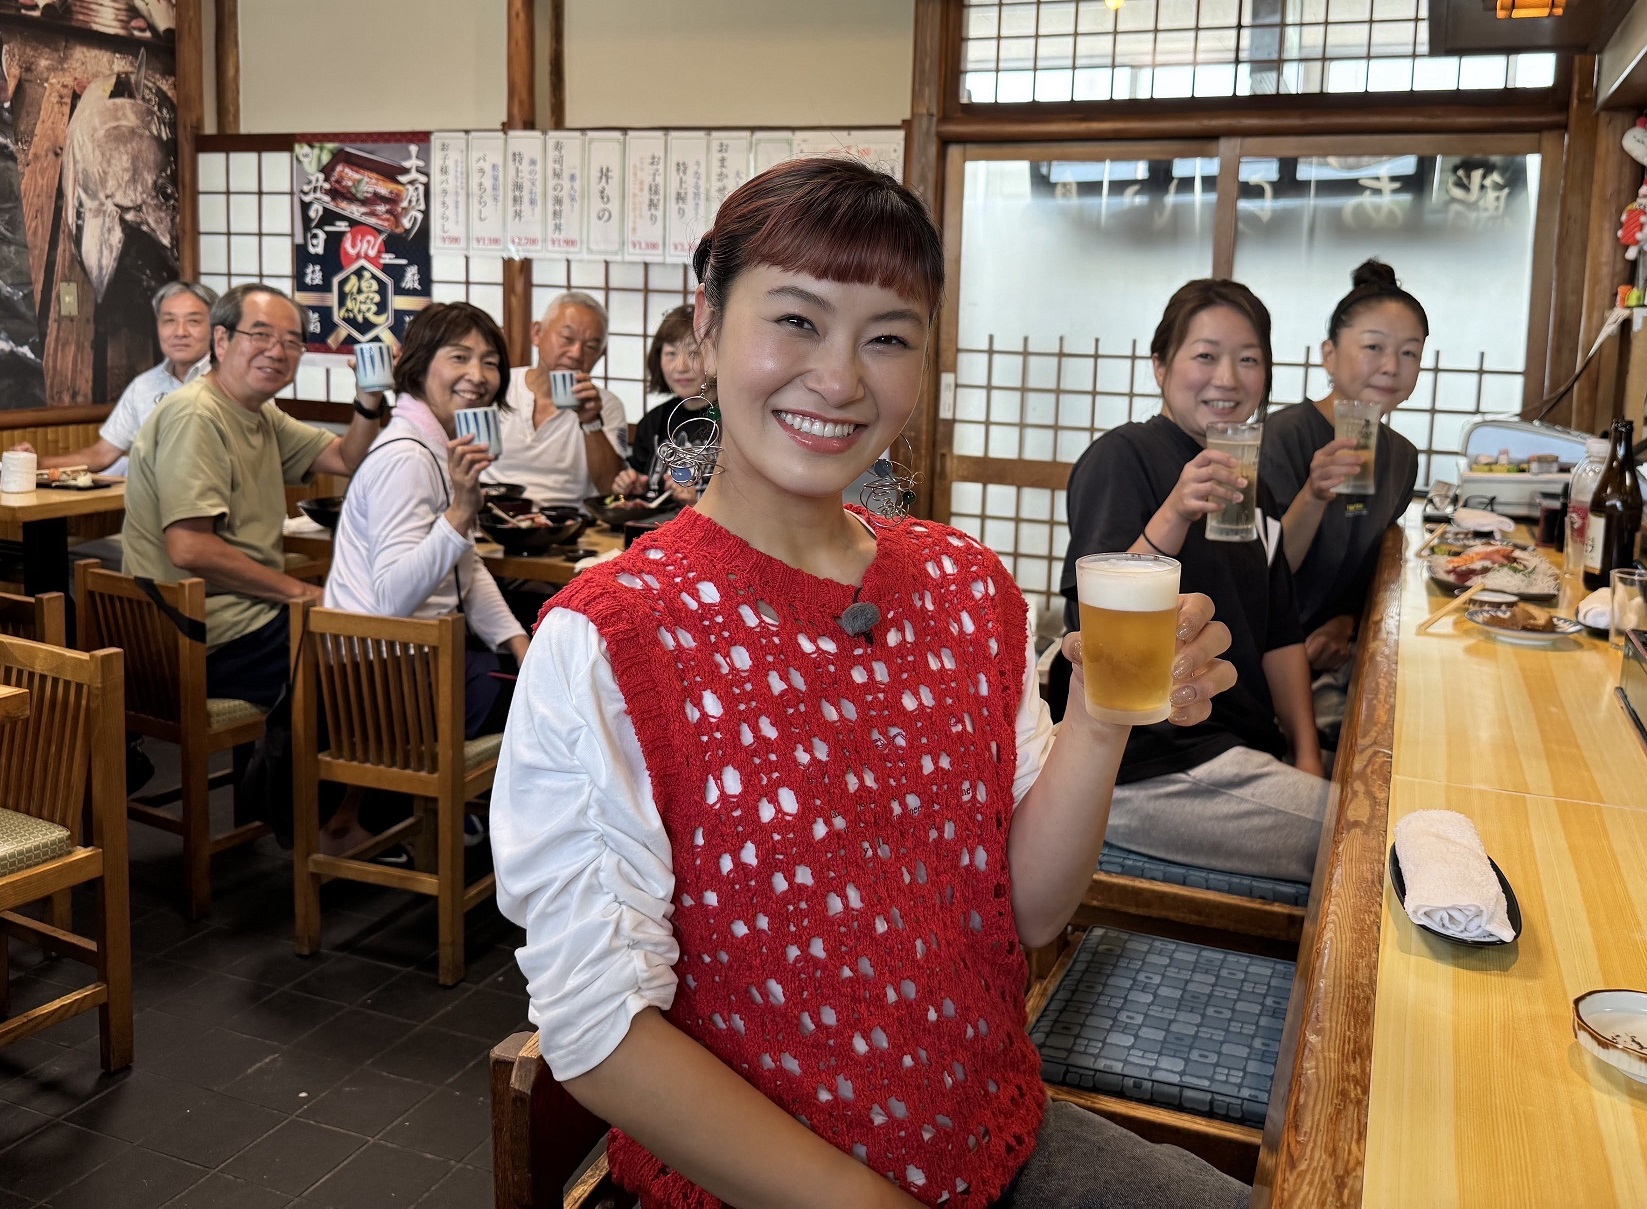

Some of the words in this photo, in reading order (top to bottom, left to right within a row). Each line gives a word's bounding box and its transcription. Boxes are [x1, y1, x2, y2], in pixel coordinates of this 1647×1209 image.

[301, 172, 331, 255] 丑の日
[396, 144, 428, 240] 土用の
[476, 153, 488, 222] バラちらし
[512, 151, 524, 222] 特上海鮮丼
[552, 140, 564, 236] 寿司屋の海鮮丼
[597, 165, 612, 224] 丼もの
[675, 161, 688, 220] 特上握り
[339, 270, 388, 325] 鰻
